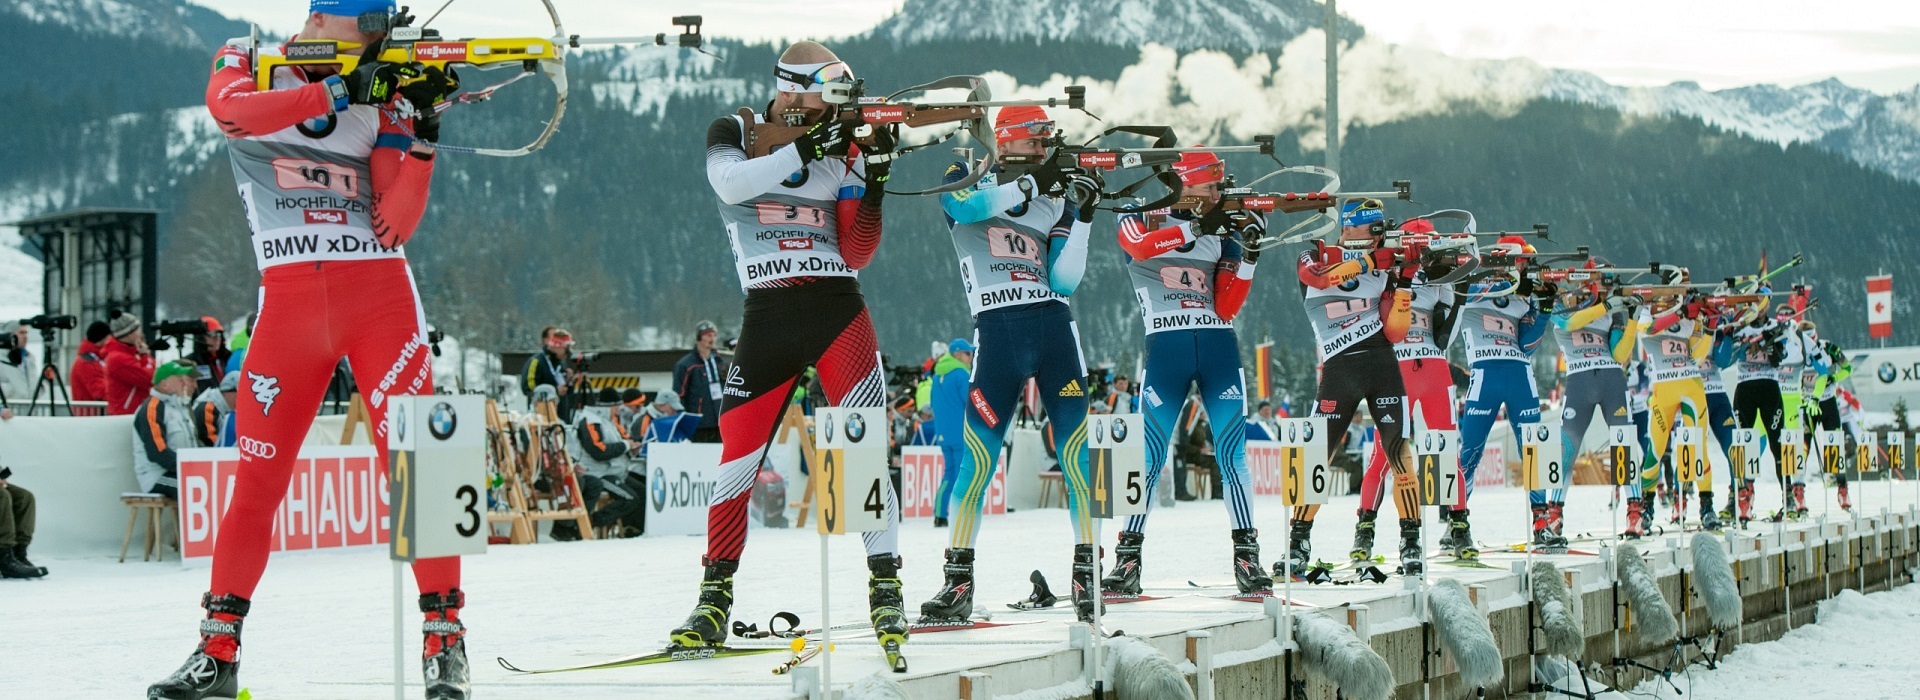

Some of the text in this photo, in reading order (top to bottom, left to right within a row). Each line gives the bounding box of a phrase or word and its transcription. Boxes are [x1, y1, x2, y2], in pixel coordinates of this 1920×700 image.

[286, 44, 334, 56] FIOCCHI
[262, 234, 319, 260] BMW
[1004, 232, 1027, 256] 10
[747, 258, 792, 280] BMW
[1181, 271, 1192, 288] 4
[981, 287, 1023, 307] BMW
[1153, 314, 1191, 330] BMW
[1323, 332, 1353, 355] BMW
[1581, 332, 1594, 344] 15
[1394, 348, 1412, 359] MW
[1475, 348, 1502, 359] BMW
[1568, 360, 1592, 372] BMW
[1657, 371, 1679, 381] BMW
[1059, 389, 1084, 397] adidas
[1616, 445, 1626, 486] 8
[1682, 444, 1690, 480] 9
[1747, 457, 1760, 475] 11
[1783, 444, 1795, 474] 11
[1824, 445, 1839, 474] 12
[1857, 445, 1869, 471] 13
[1888, 444, 1901, 469] 14
[1095, 448, 1107, 515] 4
[1288, 448, 1298, 505] 5
[1312, 464, 1325, 494] 6
[1424, 454, 1435, 505] 6
[1548, 461, 1560, 484] 8
[1629, 460, 1637, 481] 9
[824, 449, 836, 534] 3
[1126, 470, 1141, 506] 5
[1445, 474, 1456, 499] 7
[395, 450, 409, 559] 2
[455, 484, 481, 538] 3
[863, 478, 885, 520] 4
[912, 620, 975, 630] MADSHUS
[671, 648, 716, 661] FISCHER
